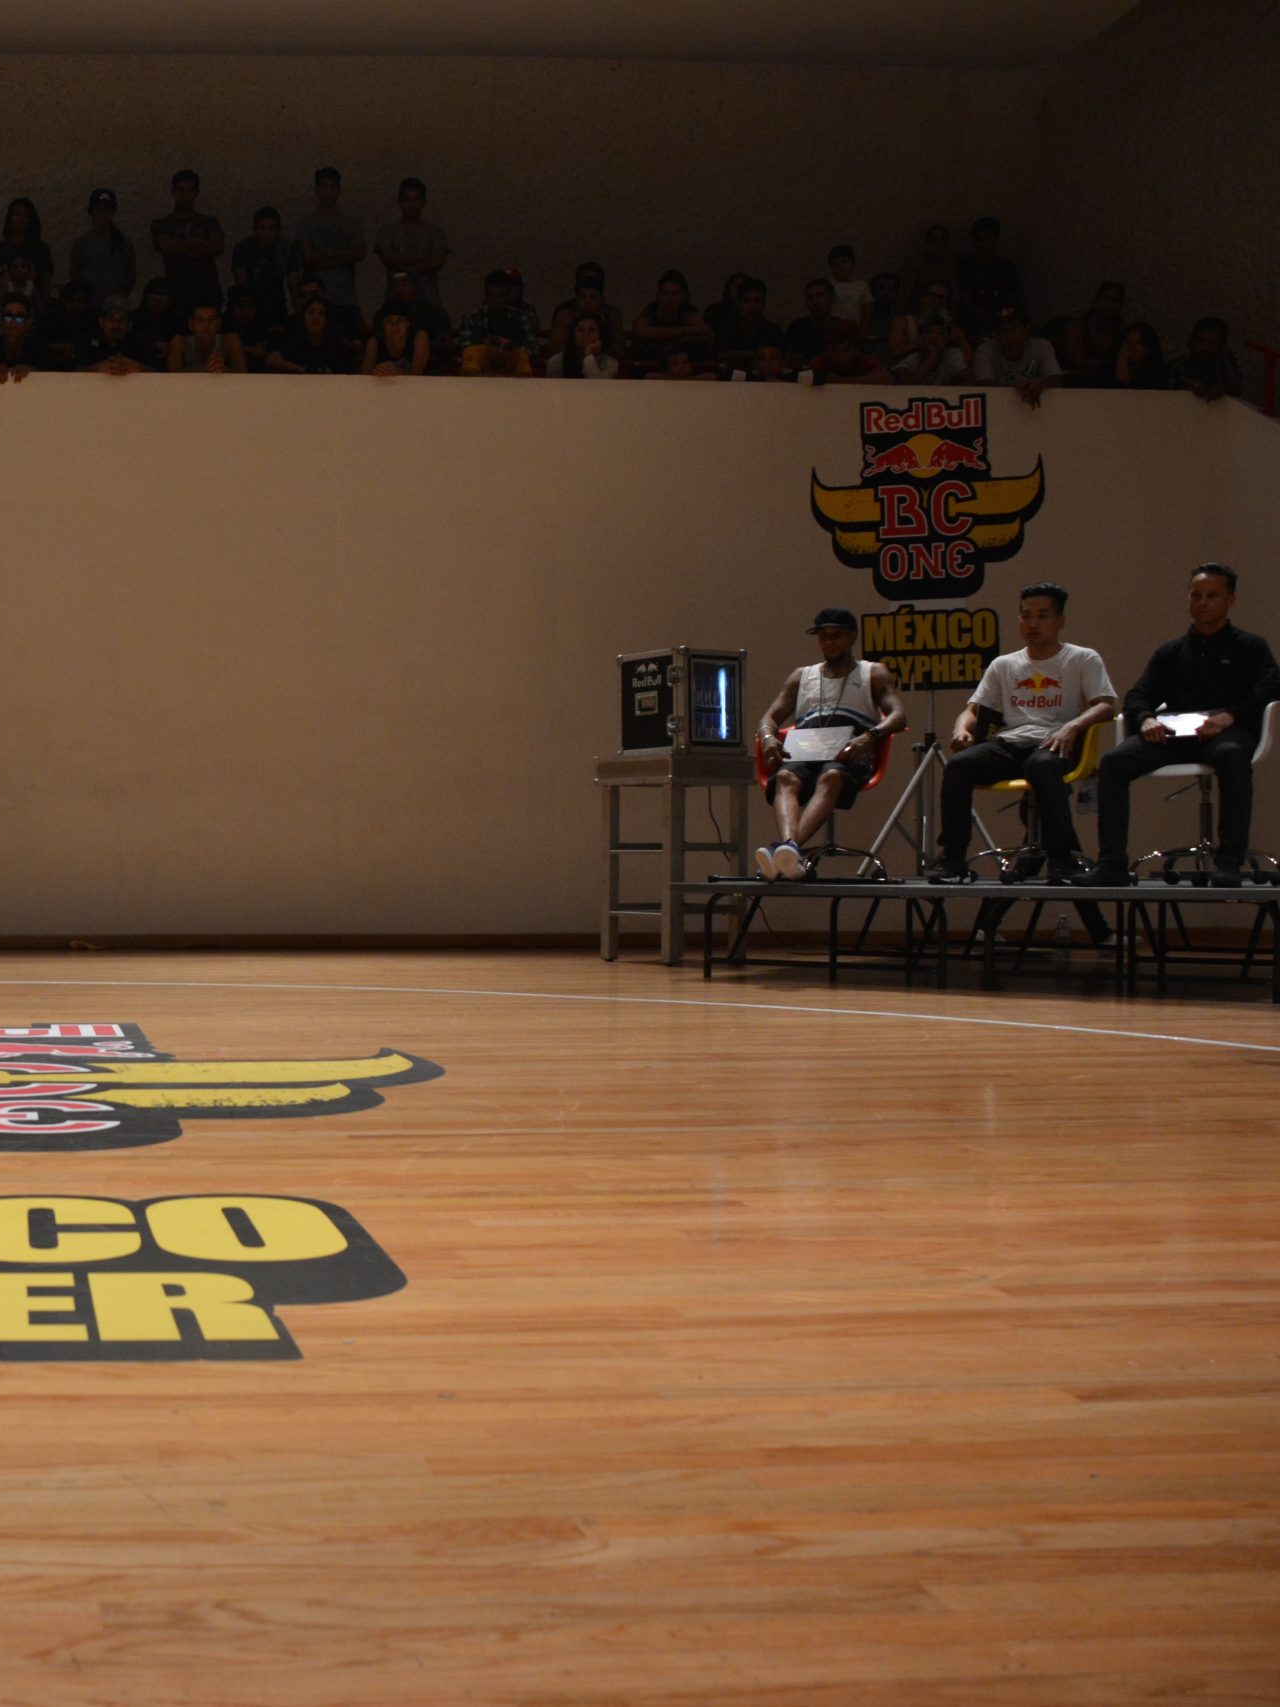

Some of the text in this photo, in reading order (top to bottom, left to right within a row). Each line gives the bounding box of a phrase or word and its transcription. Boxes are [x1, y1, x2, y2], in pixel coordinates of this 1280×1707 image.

[864, 400, 982, 433] Red Bull
[877, 480, 974, 539] BC
[879, 540, 975, 581] ONE
[862, 607, 997, 652] MÉXICO
[631, 673, 662, 688] Red Bull
[1010, 694, 1062, 708] Red Bull
